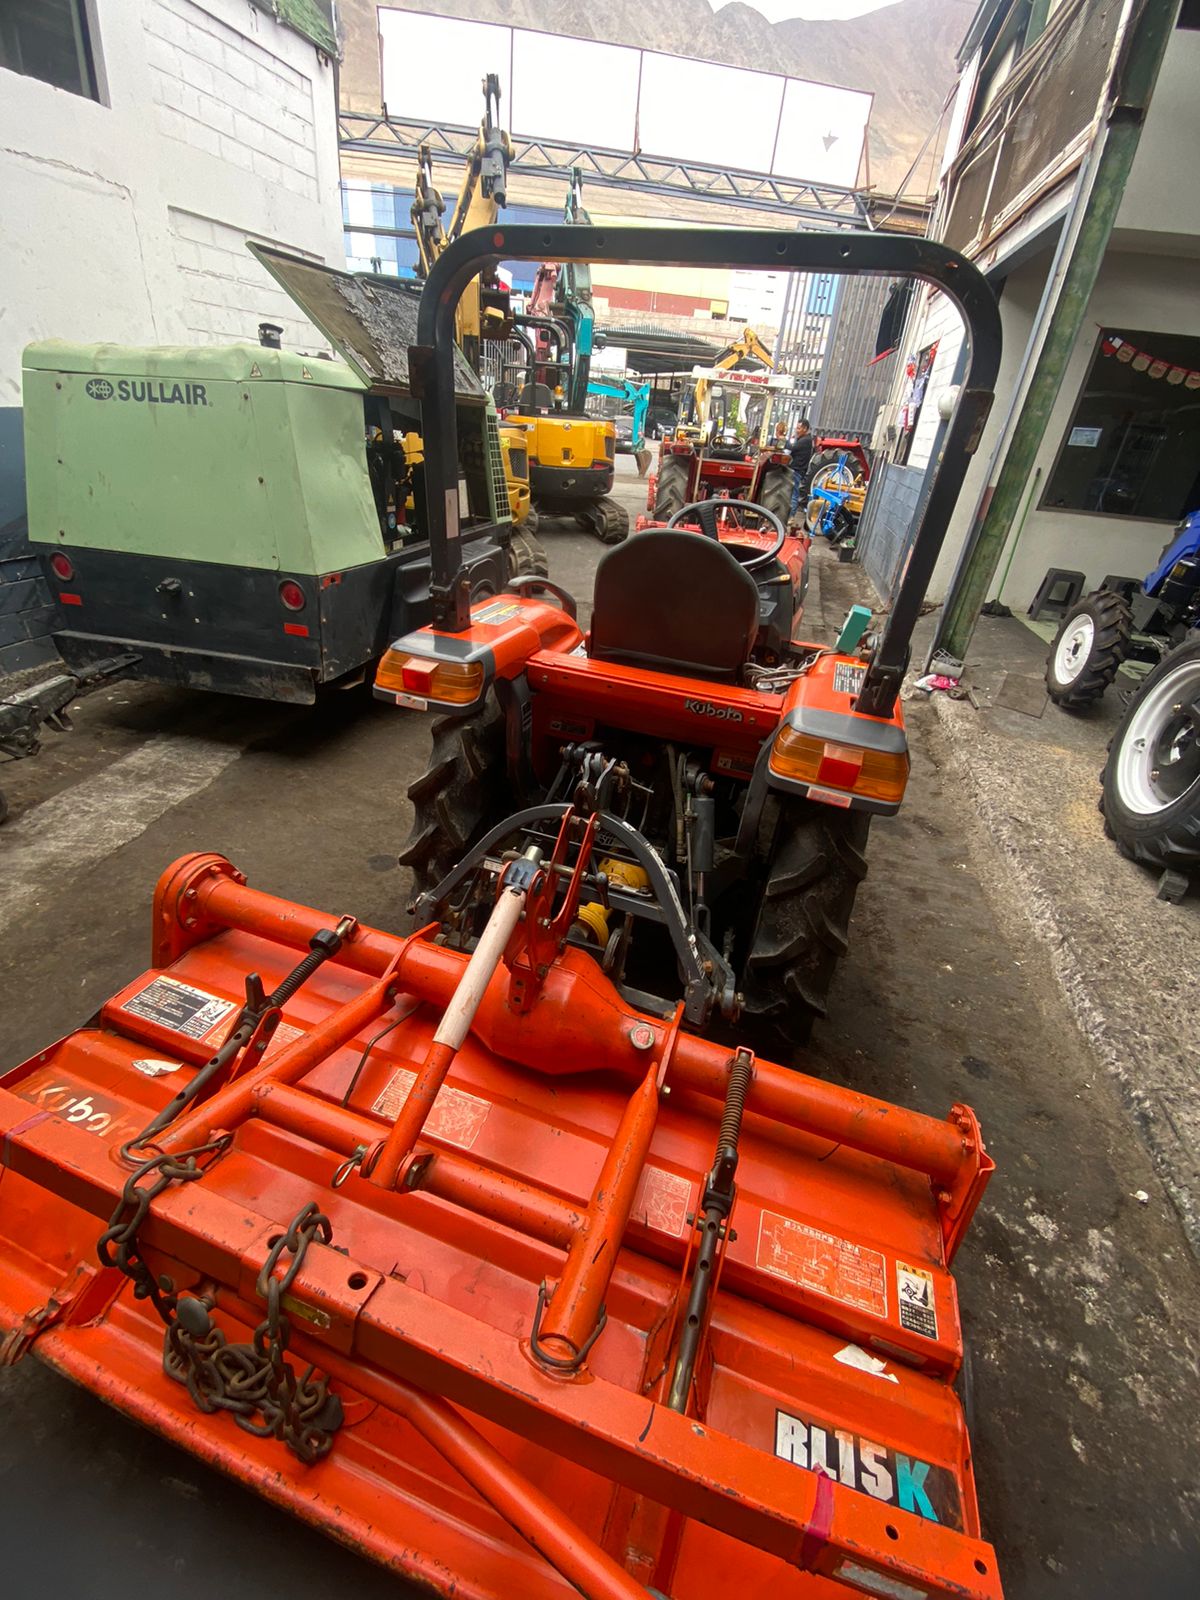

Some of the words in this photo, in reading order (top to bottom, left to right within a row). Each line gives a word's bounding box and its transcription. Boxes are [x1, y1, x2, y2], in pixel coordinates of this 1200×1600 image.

[118, 380, 208, 406] SULLAIR
[684, 699, 743, 722] Kubota
[776, 1411, 939, 1522] RL15K
